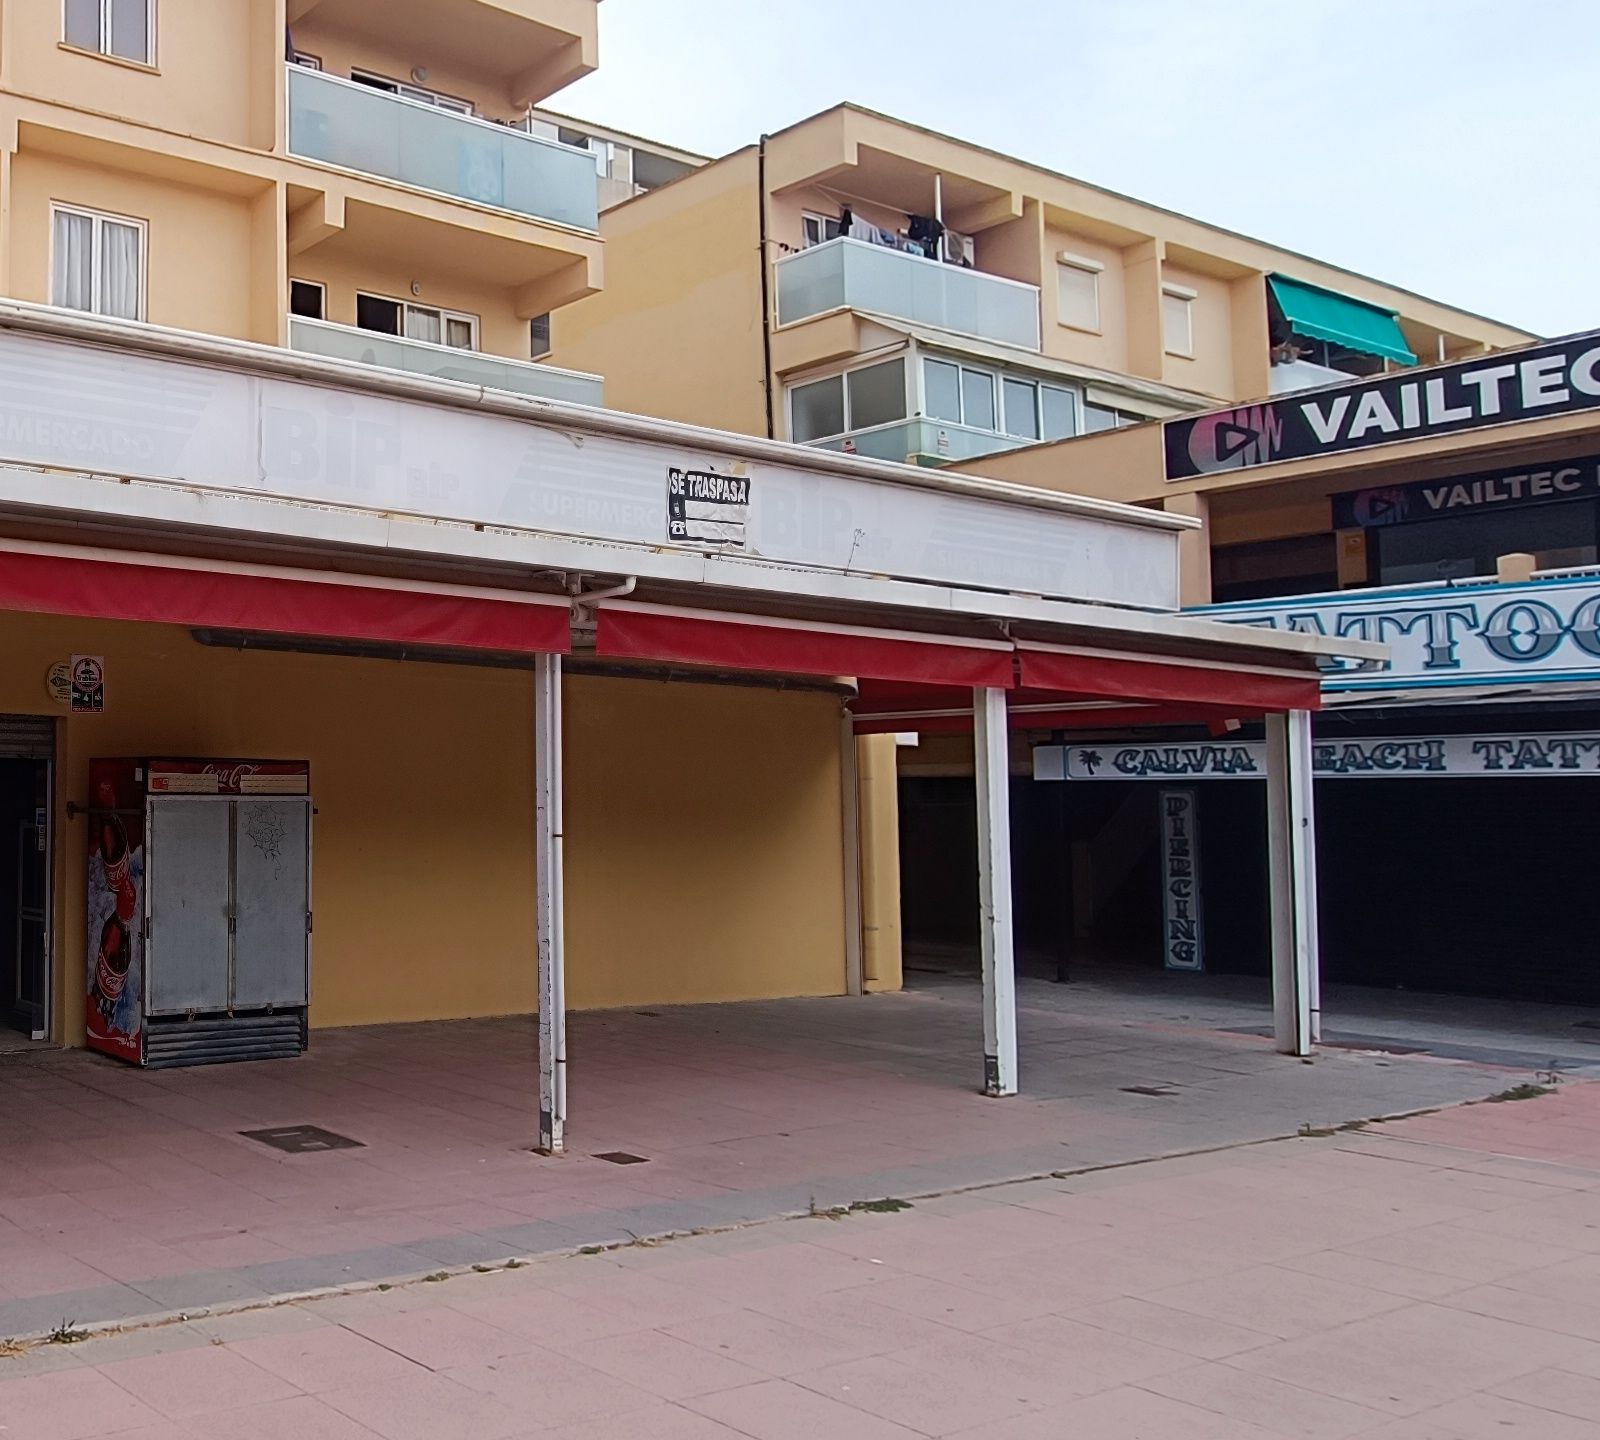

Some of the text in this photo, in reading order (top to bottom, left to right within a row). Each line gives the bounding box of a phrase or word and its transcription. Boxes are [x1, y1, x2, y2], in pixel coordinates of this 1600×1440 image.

[670, 471, 747, 503] SE TRASPASA
[1423, 467, 1583, 511] VAILTEC
[529, 490, 667, 532] SUPERMERC
[1212, 594, 1600, 671] TTO
[1112, 746, 1259, 776] CALVIA
[1312, 740, 1446, 772] EACH
[1165, 796, 1197, 963] PIERCING
